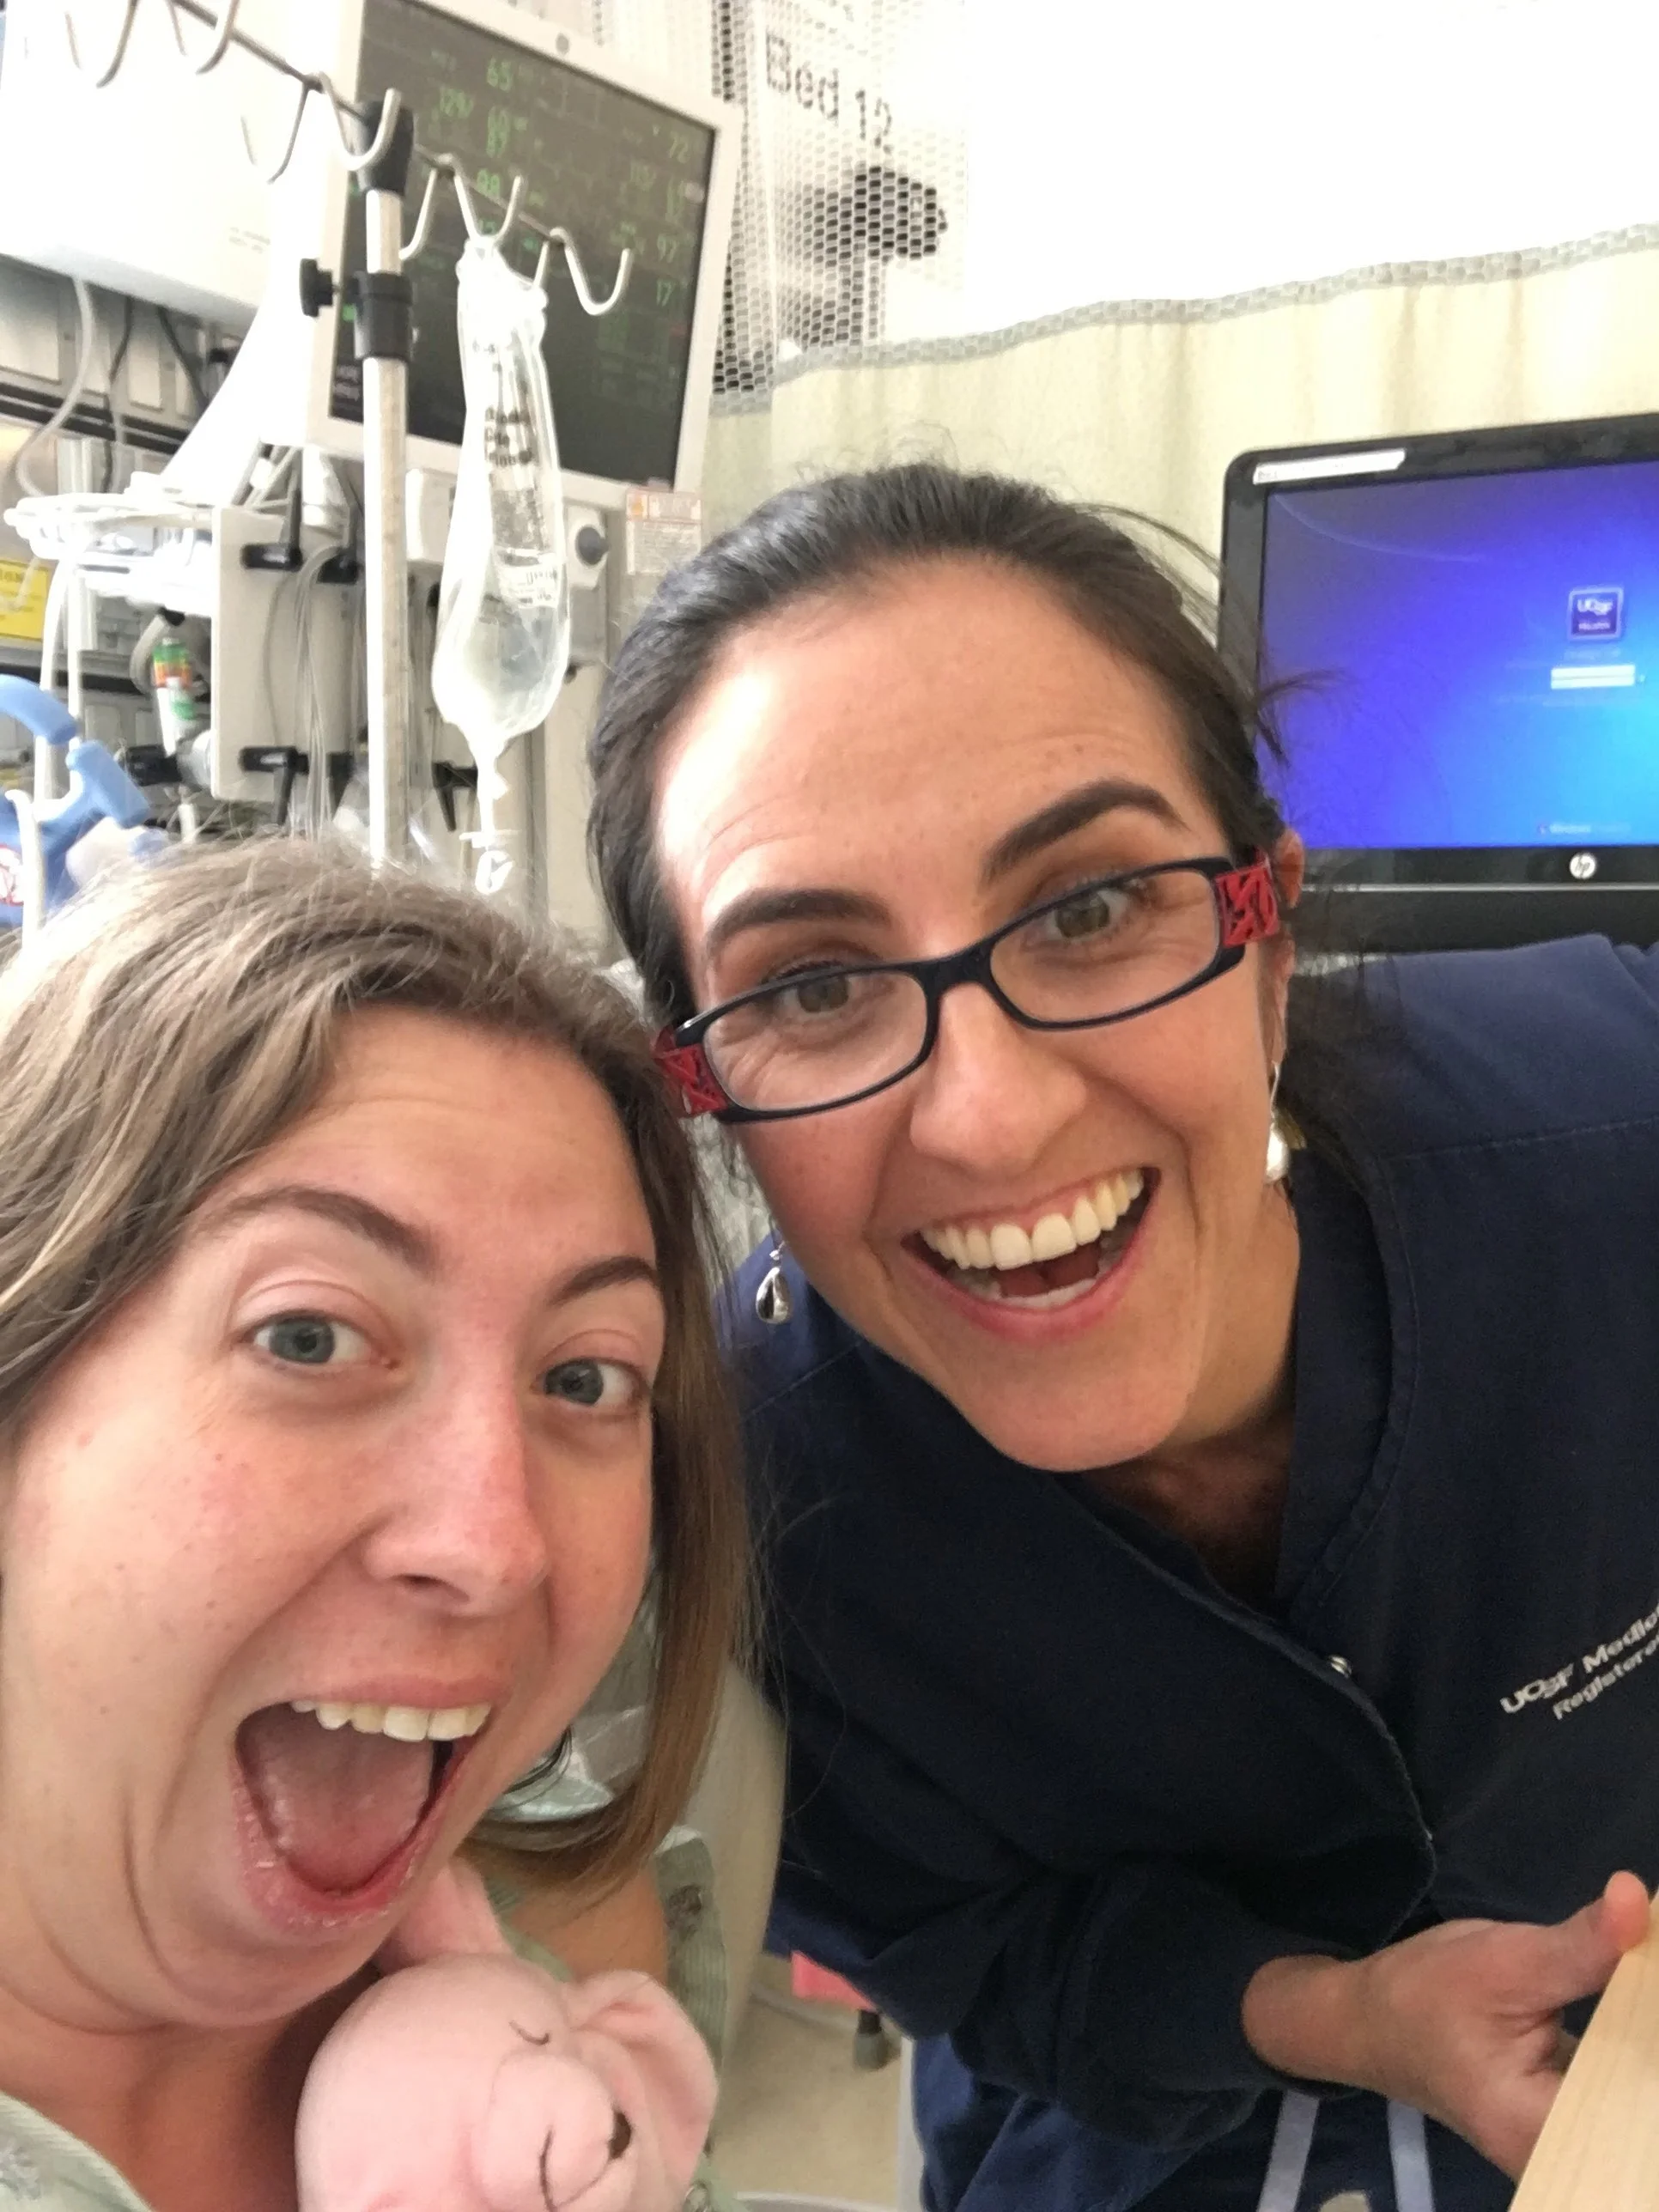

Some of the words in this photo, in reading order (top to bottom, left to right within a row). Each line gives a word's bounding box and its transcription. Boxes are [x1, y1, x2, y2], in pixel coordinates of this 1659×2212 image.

[766, 33, 839, 125] Bed
[855, 89, 893, 155] 12
[1500, 1662, 1574, 1713] UCSF
[1582, 1601, 1659, 1674] Medic
[1553, 1630, 1659, 1720] Registere
